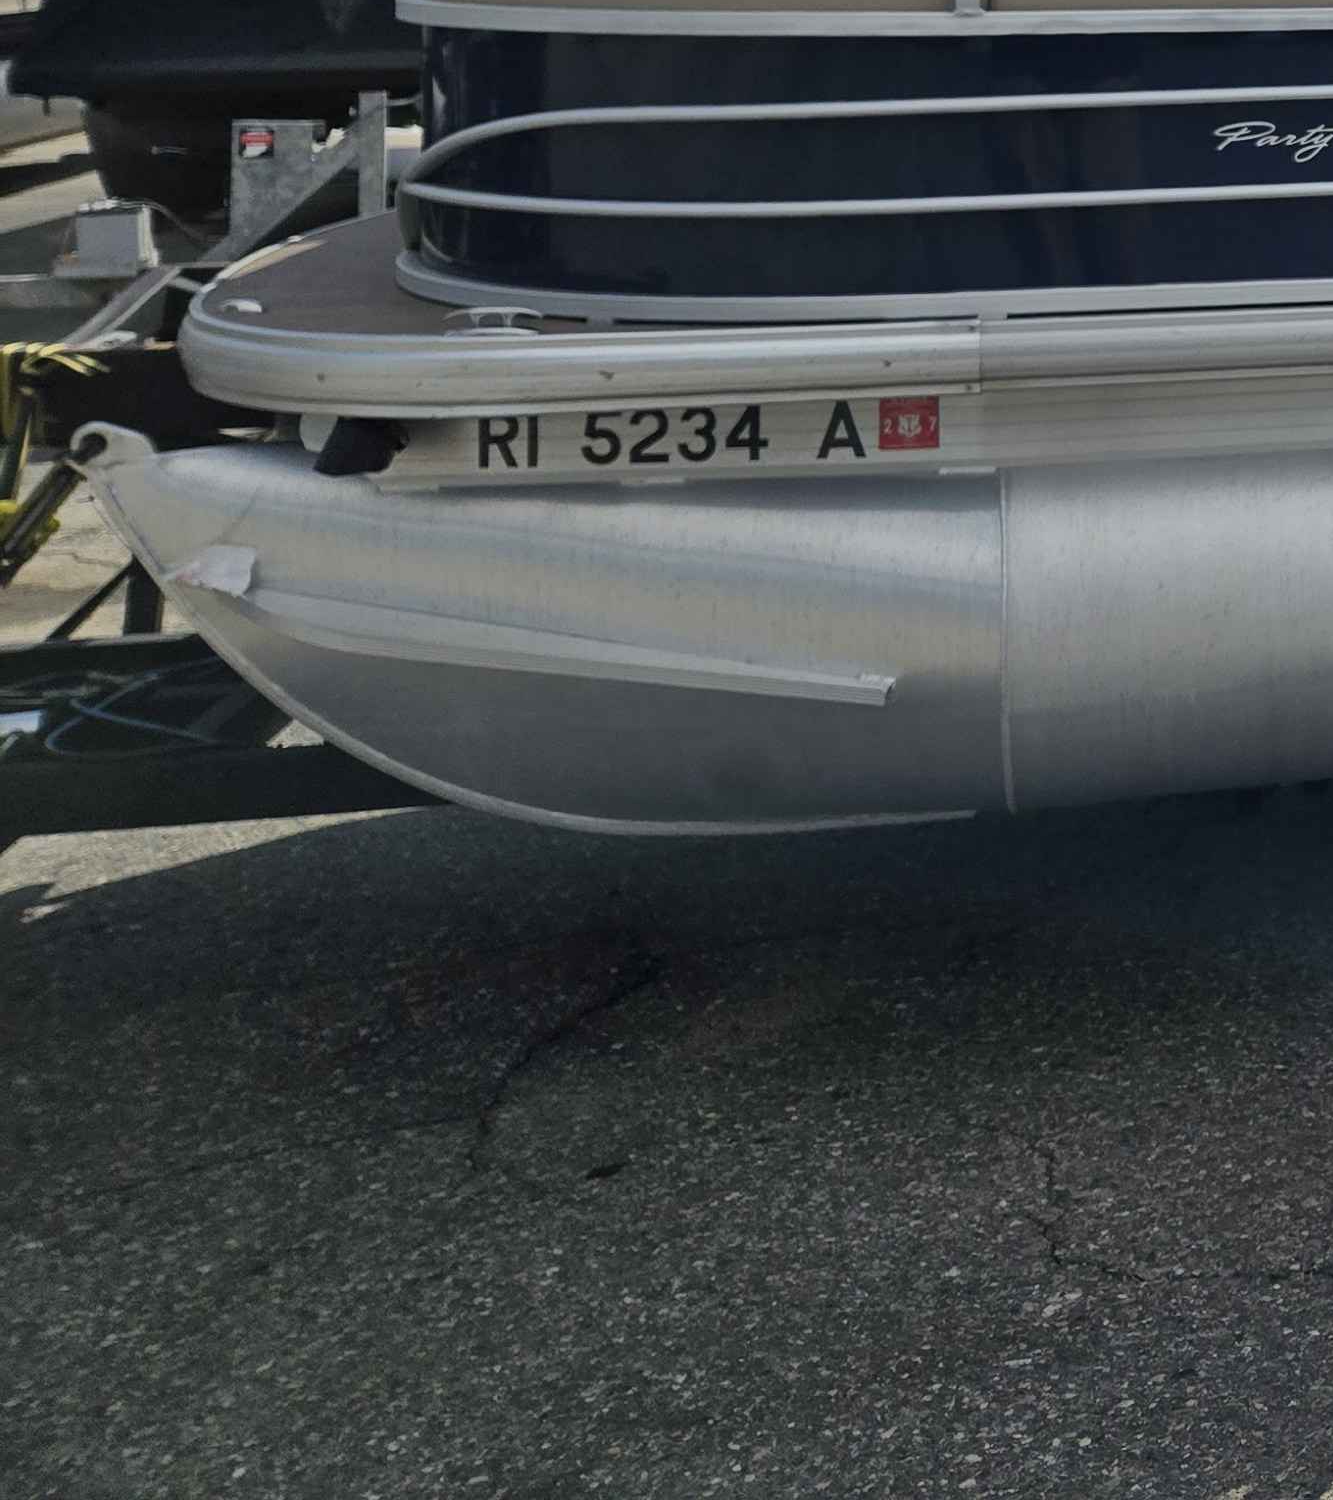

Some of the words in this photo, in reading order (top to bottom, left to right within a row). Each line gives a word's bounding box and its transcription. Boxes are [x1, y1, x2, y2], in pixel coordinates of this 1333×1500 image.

[478, 415, 539, 468] RI
[581, 405, 768, 466] 5234
[817, 400, 866, 460] A
